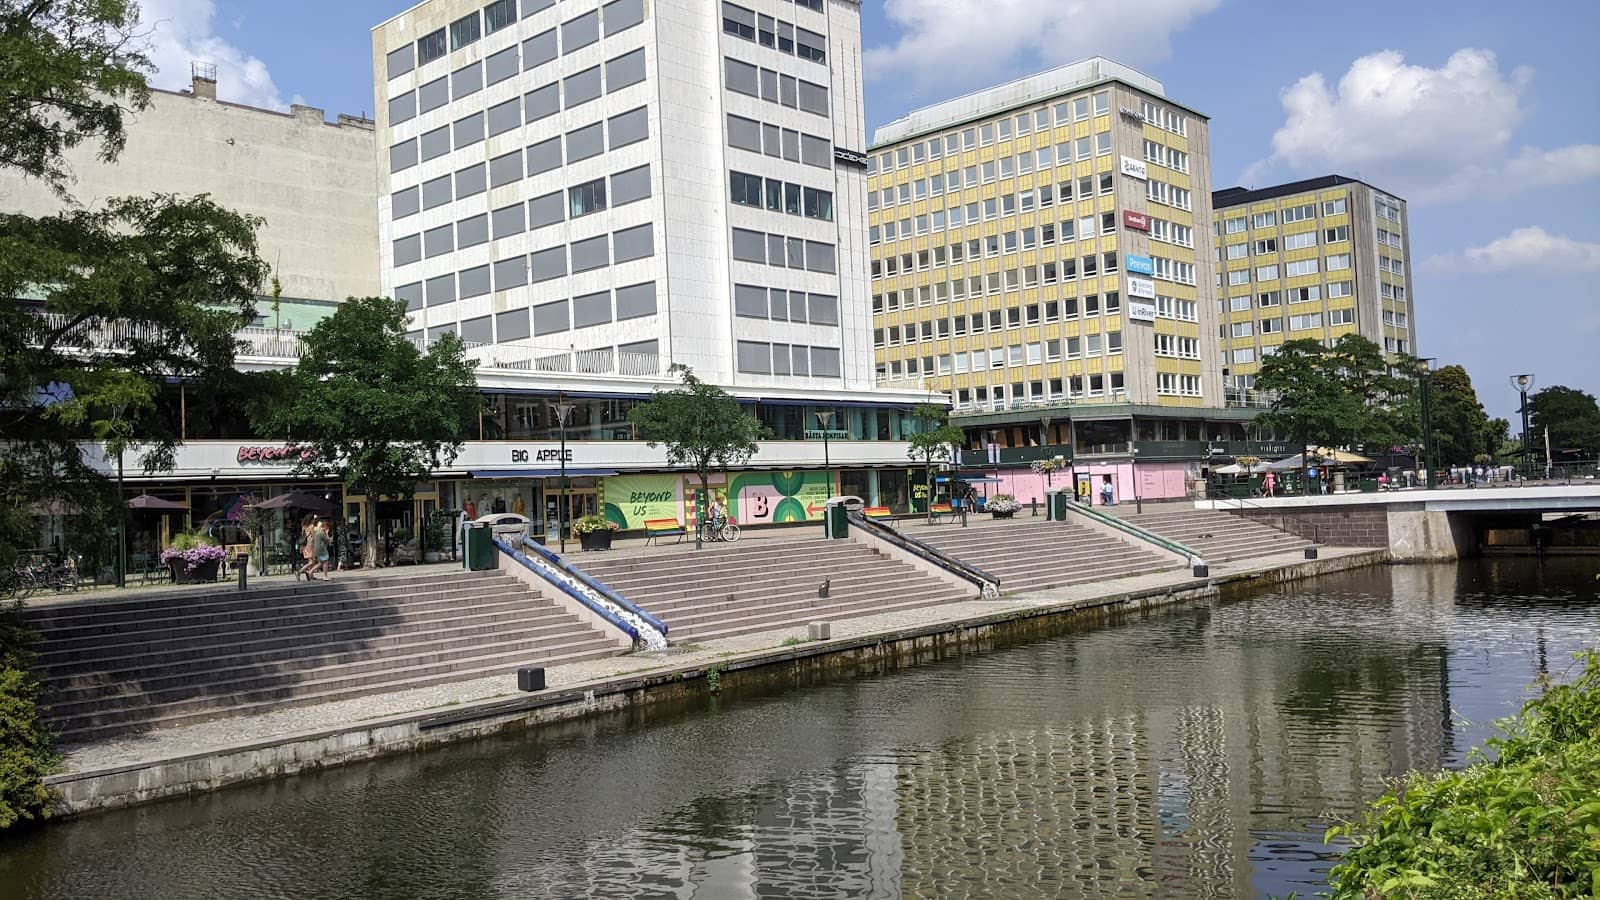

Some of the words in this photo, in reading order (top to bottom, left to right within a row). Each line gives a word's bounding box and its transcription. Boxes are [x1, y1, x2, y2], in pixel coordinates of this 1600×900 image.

[1129, 257, 1152, 271] Prevas
[511, 449, 529, 462] BIG
[536, 449, 573, 462] APPLE
[630, 490, 672, 504] BEYOND
[634, 505, 647, 516] US
